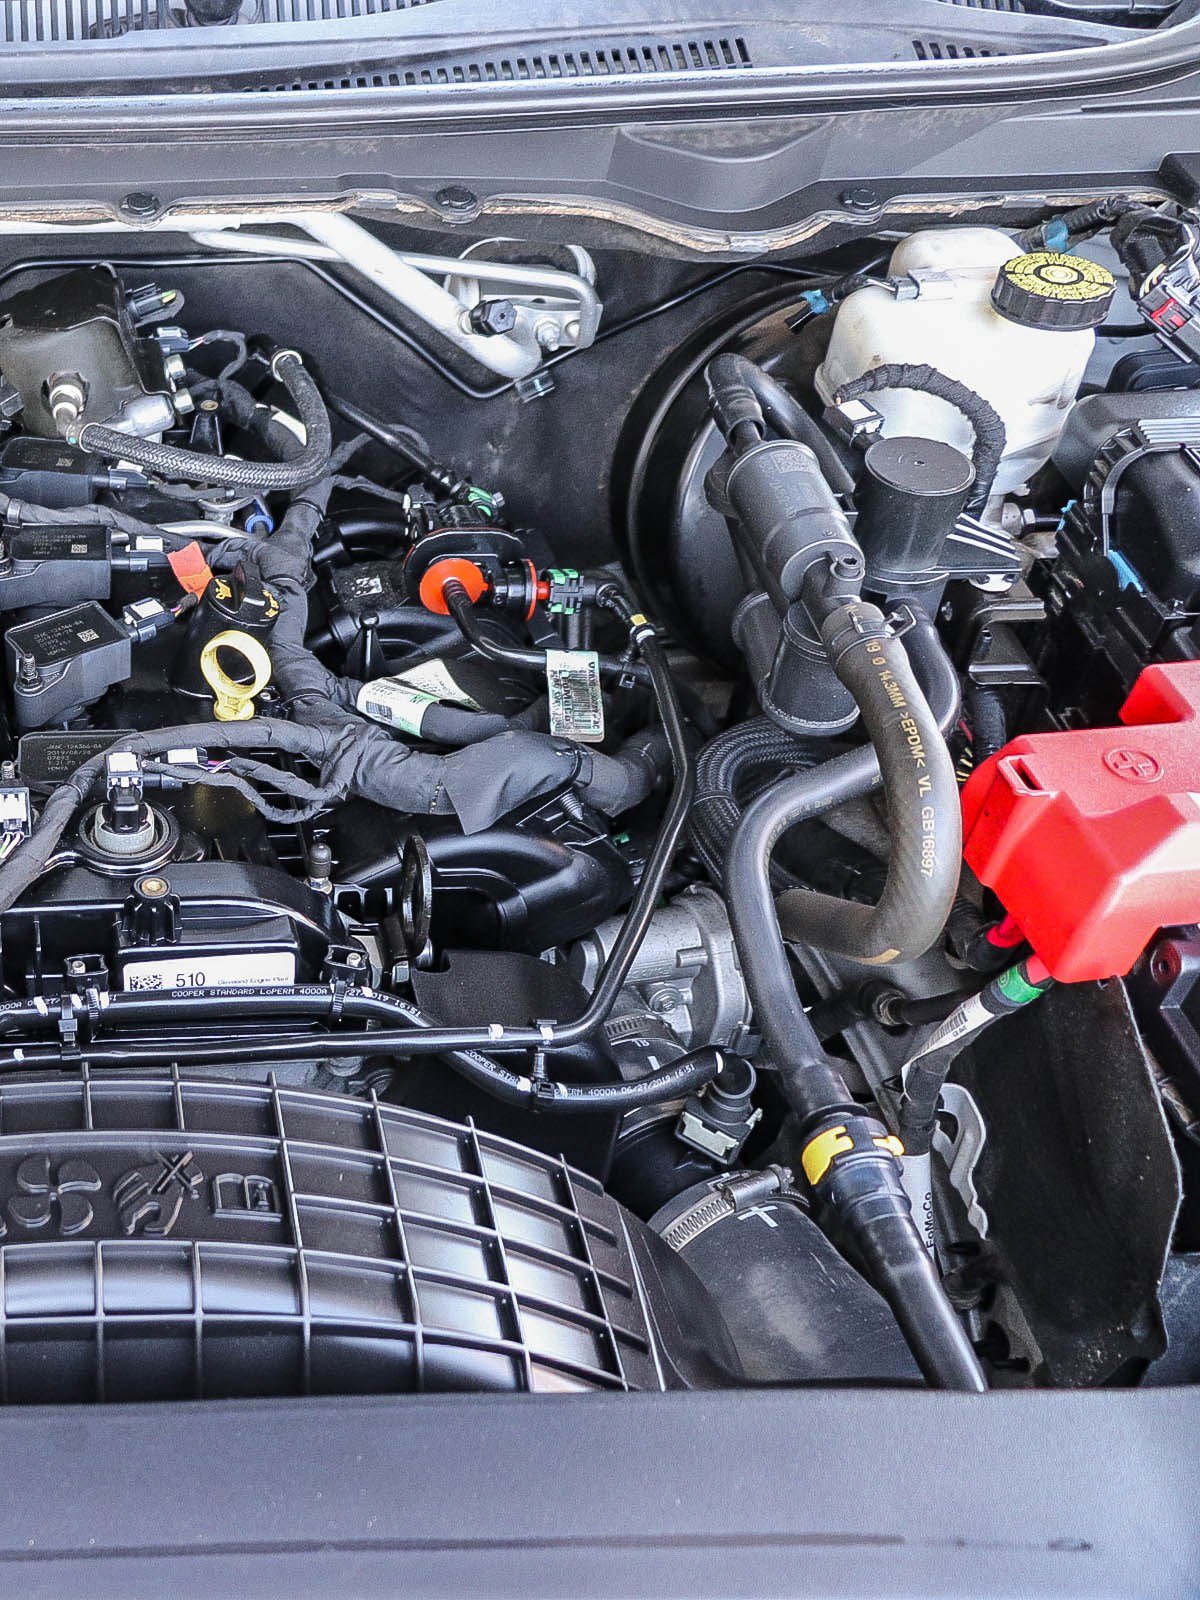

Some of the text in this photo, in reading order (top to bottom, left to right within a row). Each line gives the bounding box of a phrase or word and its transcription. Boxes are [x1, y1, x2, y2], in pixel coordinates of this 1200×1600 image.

[865, 641, 881, 653] 19
[878, 670, 907, 709] 14.3MM
[900, 711, 926, 769] >EPDM<
[917, 774, 932, 798] VL
[920, 806, 936, 878] GB16897
[171, 990, 205, 998] COOPER
[209, 988, 255, 996] STANDARD
[300, 987, 328, 995] 4000A
[175, 972, 206, 988] 510
[465, 1050, 497, 1072] COOPER
[588, 1087, 617, 1097] 4000A
[620, 1076, 671, 1095] 06/27/2019
[674, 1064, 695, 1081] 16:51
[923, 1191, 935, 1249] FoMoCo
